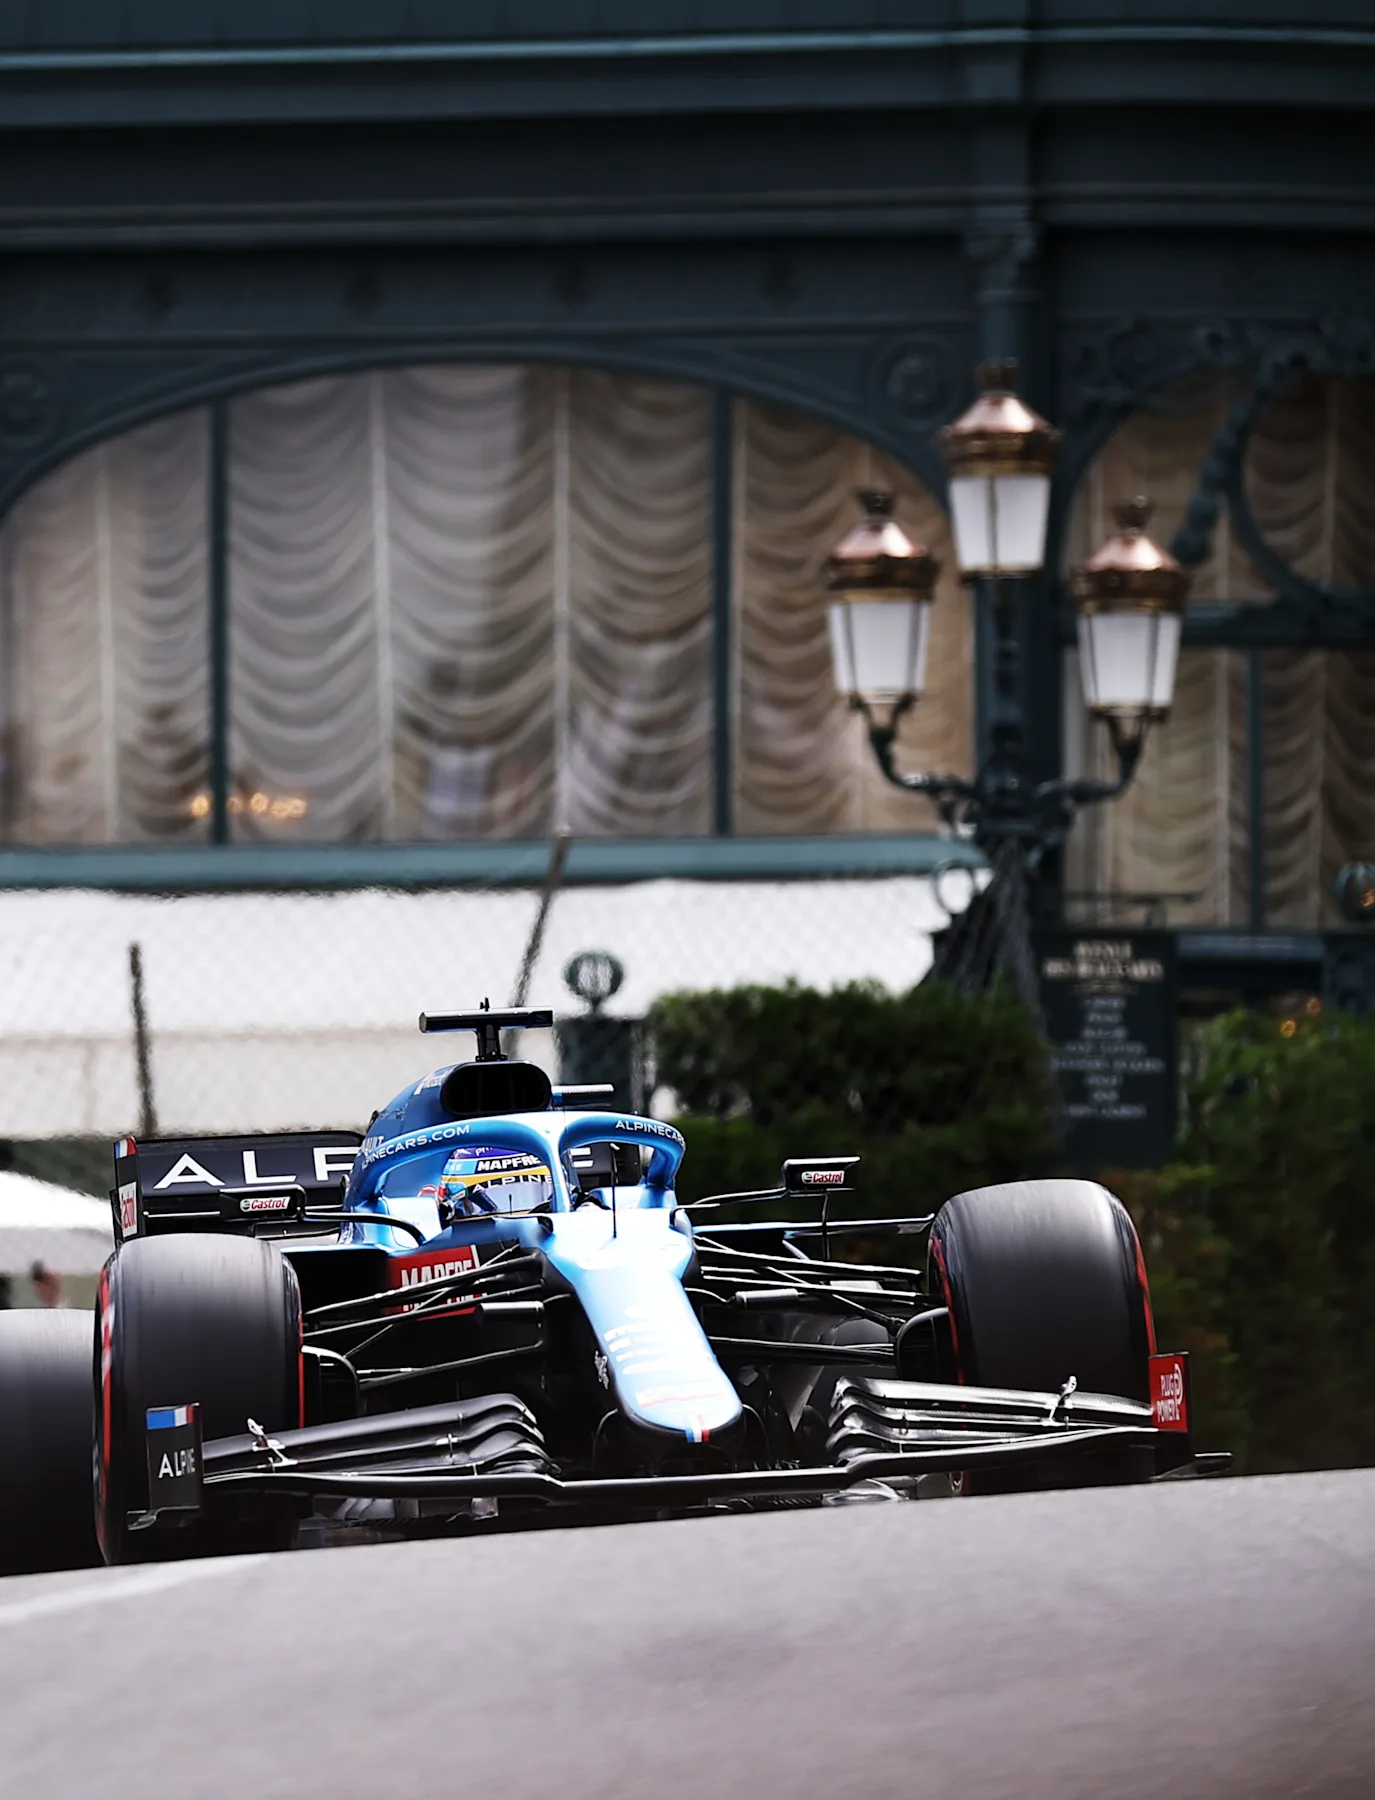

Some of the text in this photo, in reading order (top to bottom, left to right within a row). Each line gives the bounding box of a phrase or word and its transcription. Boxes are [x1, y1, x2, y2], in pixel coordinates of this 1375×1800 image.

[477, 1154, 542, 1172] MAPFRE
[472, 1174, 553, 1194] ALPINE
[814, 1172, 843, 1183] Castrol
[251, 1197, 287, 1210] Castrol
